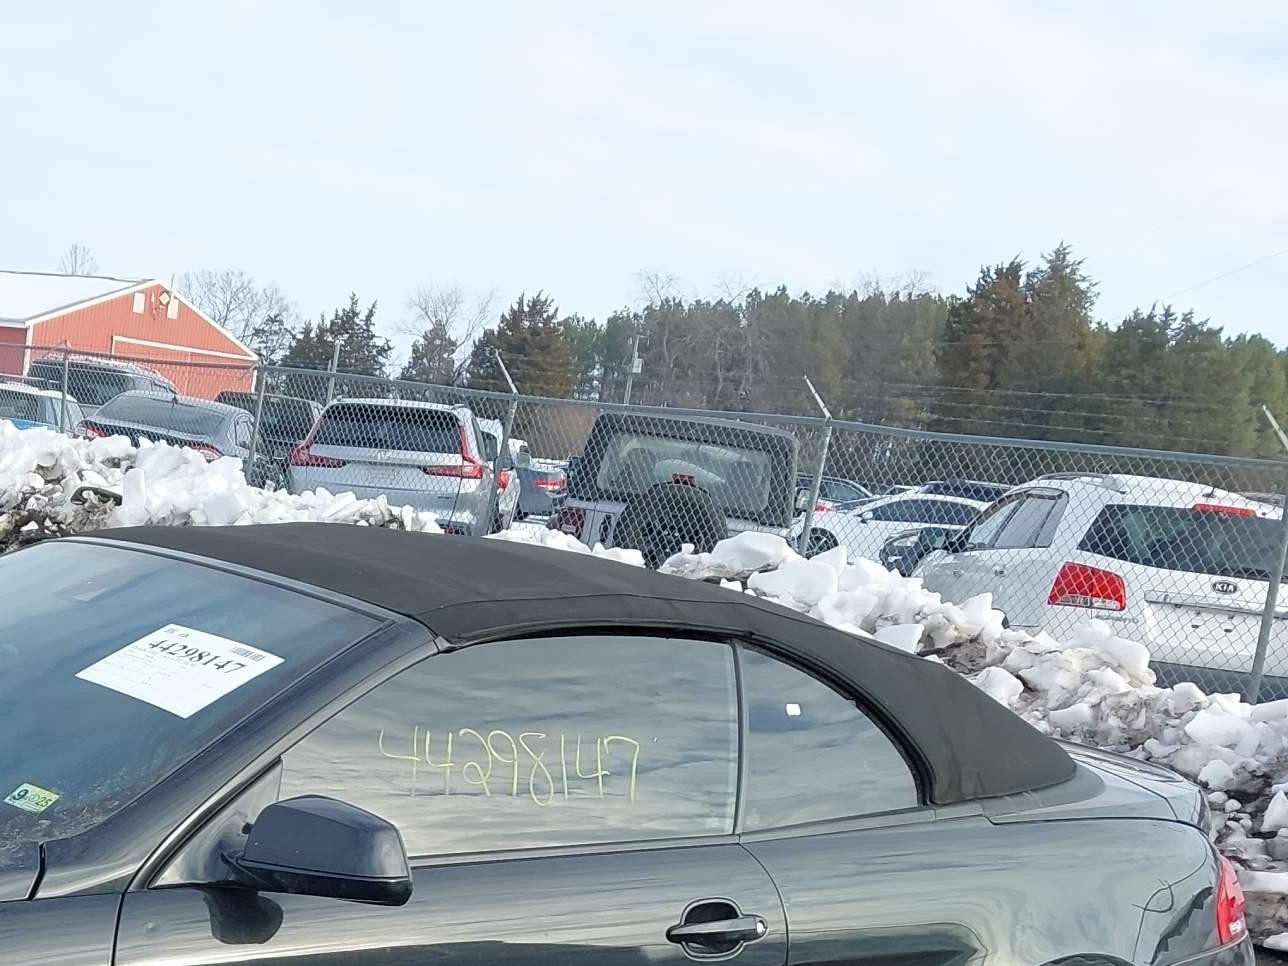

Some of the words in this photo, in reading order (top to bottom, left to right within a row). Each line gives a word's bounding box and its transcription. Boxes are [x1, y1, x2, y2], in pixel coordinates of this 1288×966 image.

[1214, 582, 1235, 594] KIA
[148, 639, 248, 674] 44298147
[378, 725, 640, 806] 44298147
